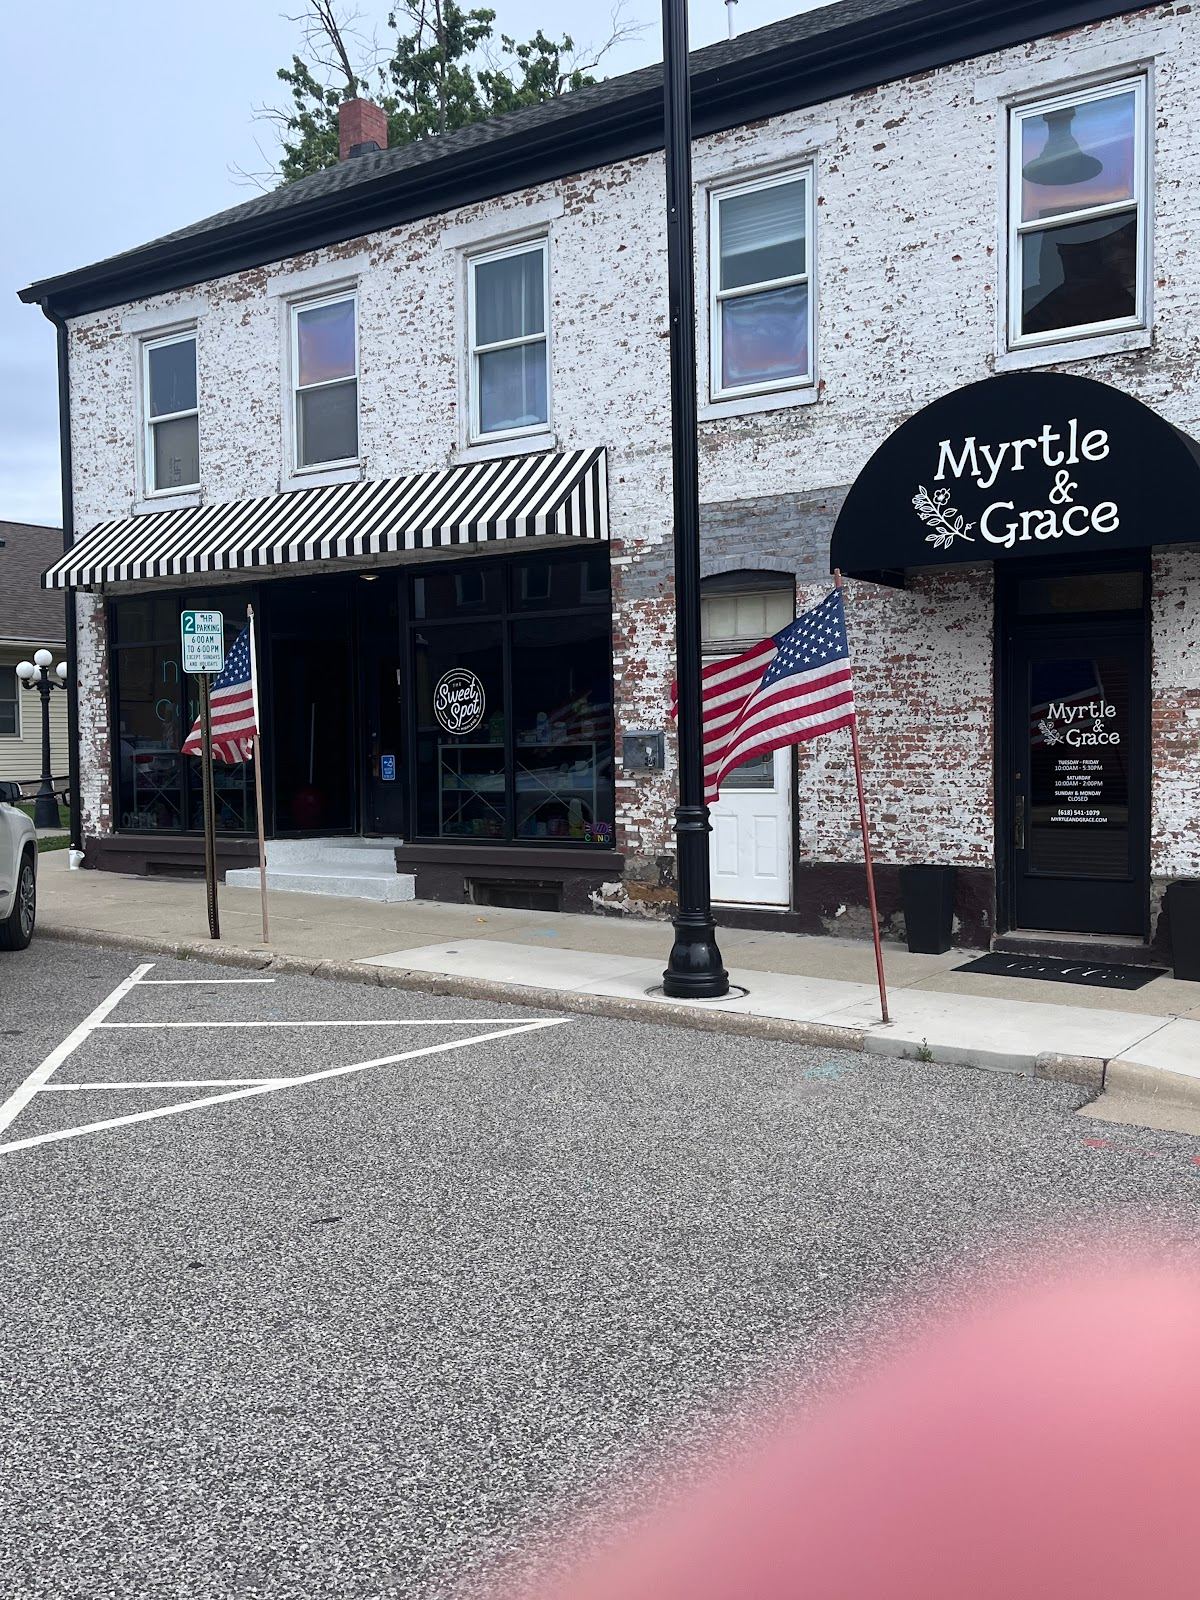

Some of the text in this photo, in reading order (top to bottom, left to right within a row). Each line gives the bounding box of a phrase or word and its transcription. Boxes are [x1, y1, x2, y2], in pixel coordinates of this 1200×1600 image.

[933, 418, 1110, 489] Myrtle
[1048, 469, 1078, 505] &
[980, 501, 1120, 549] Grace
[185, 616, 194, 631] 2
[187, 645, 195, 653] TO
[436, 677, 476, 710] Sweet
[447, 691, 479, 729] Spot
[1046, 700, 1117, 724] Myrtle
[1092, 718, 1105, 733] &
[1065, 728, 1121, 748] Grace
[1057, 808, 1101, 817] (618) 541-1079
